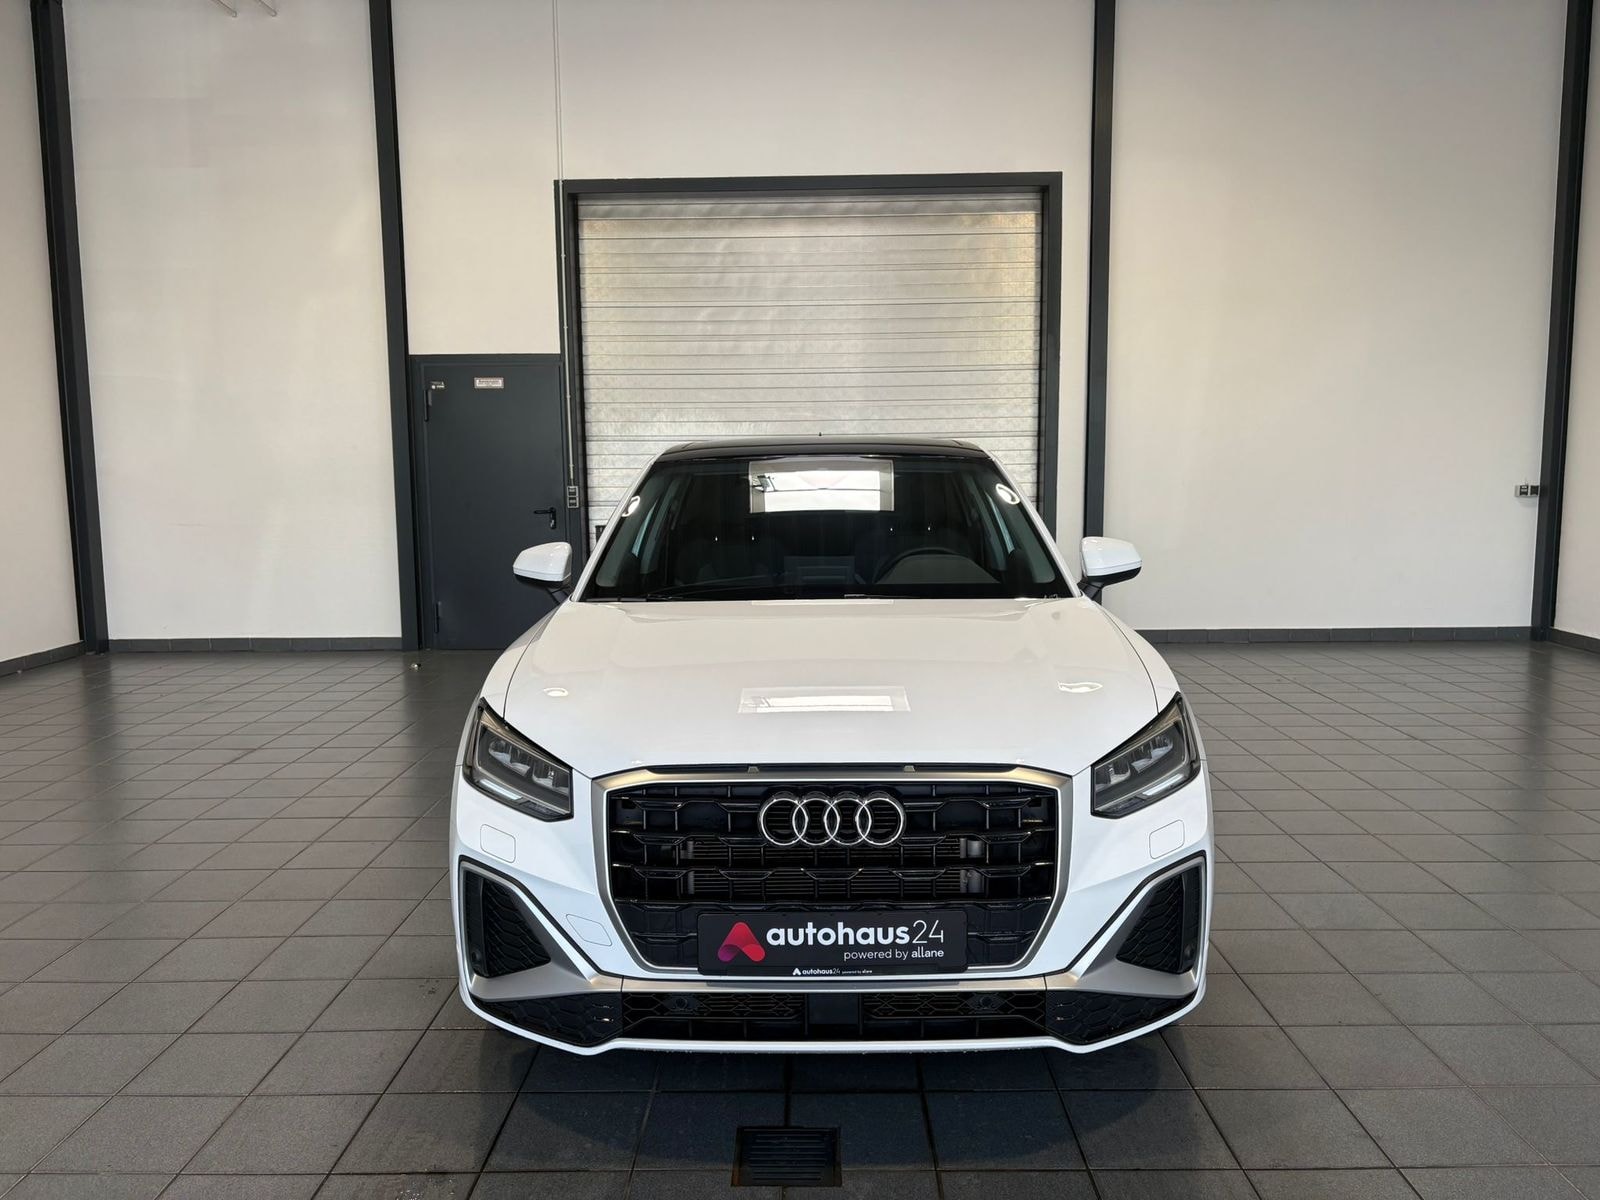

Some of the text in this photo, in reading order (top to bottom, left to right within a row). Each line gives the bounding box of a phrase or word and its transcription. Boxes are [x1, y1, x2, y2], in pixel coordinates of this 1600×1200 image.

[766, 919, 944, 946] autohaus24
[844, 947, 944, 961] powered by allane
